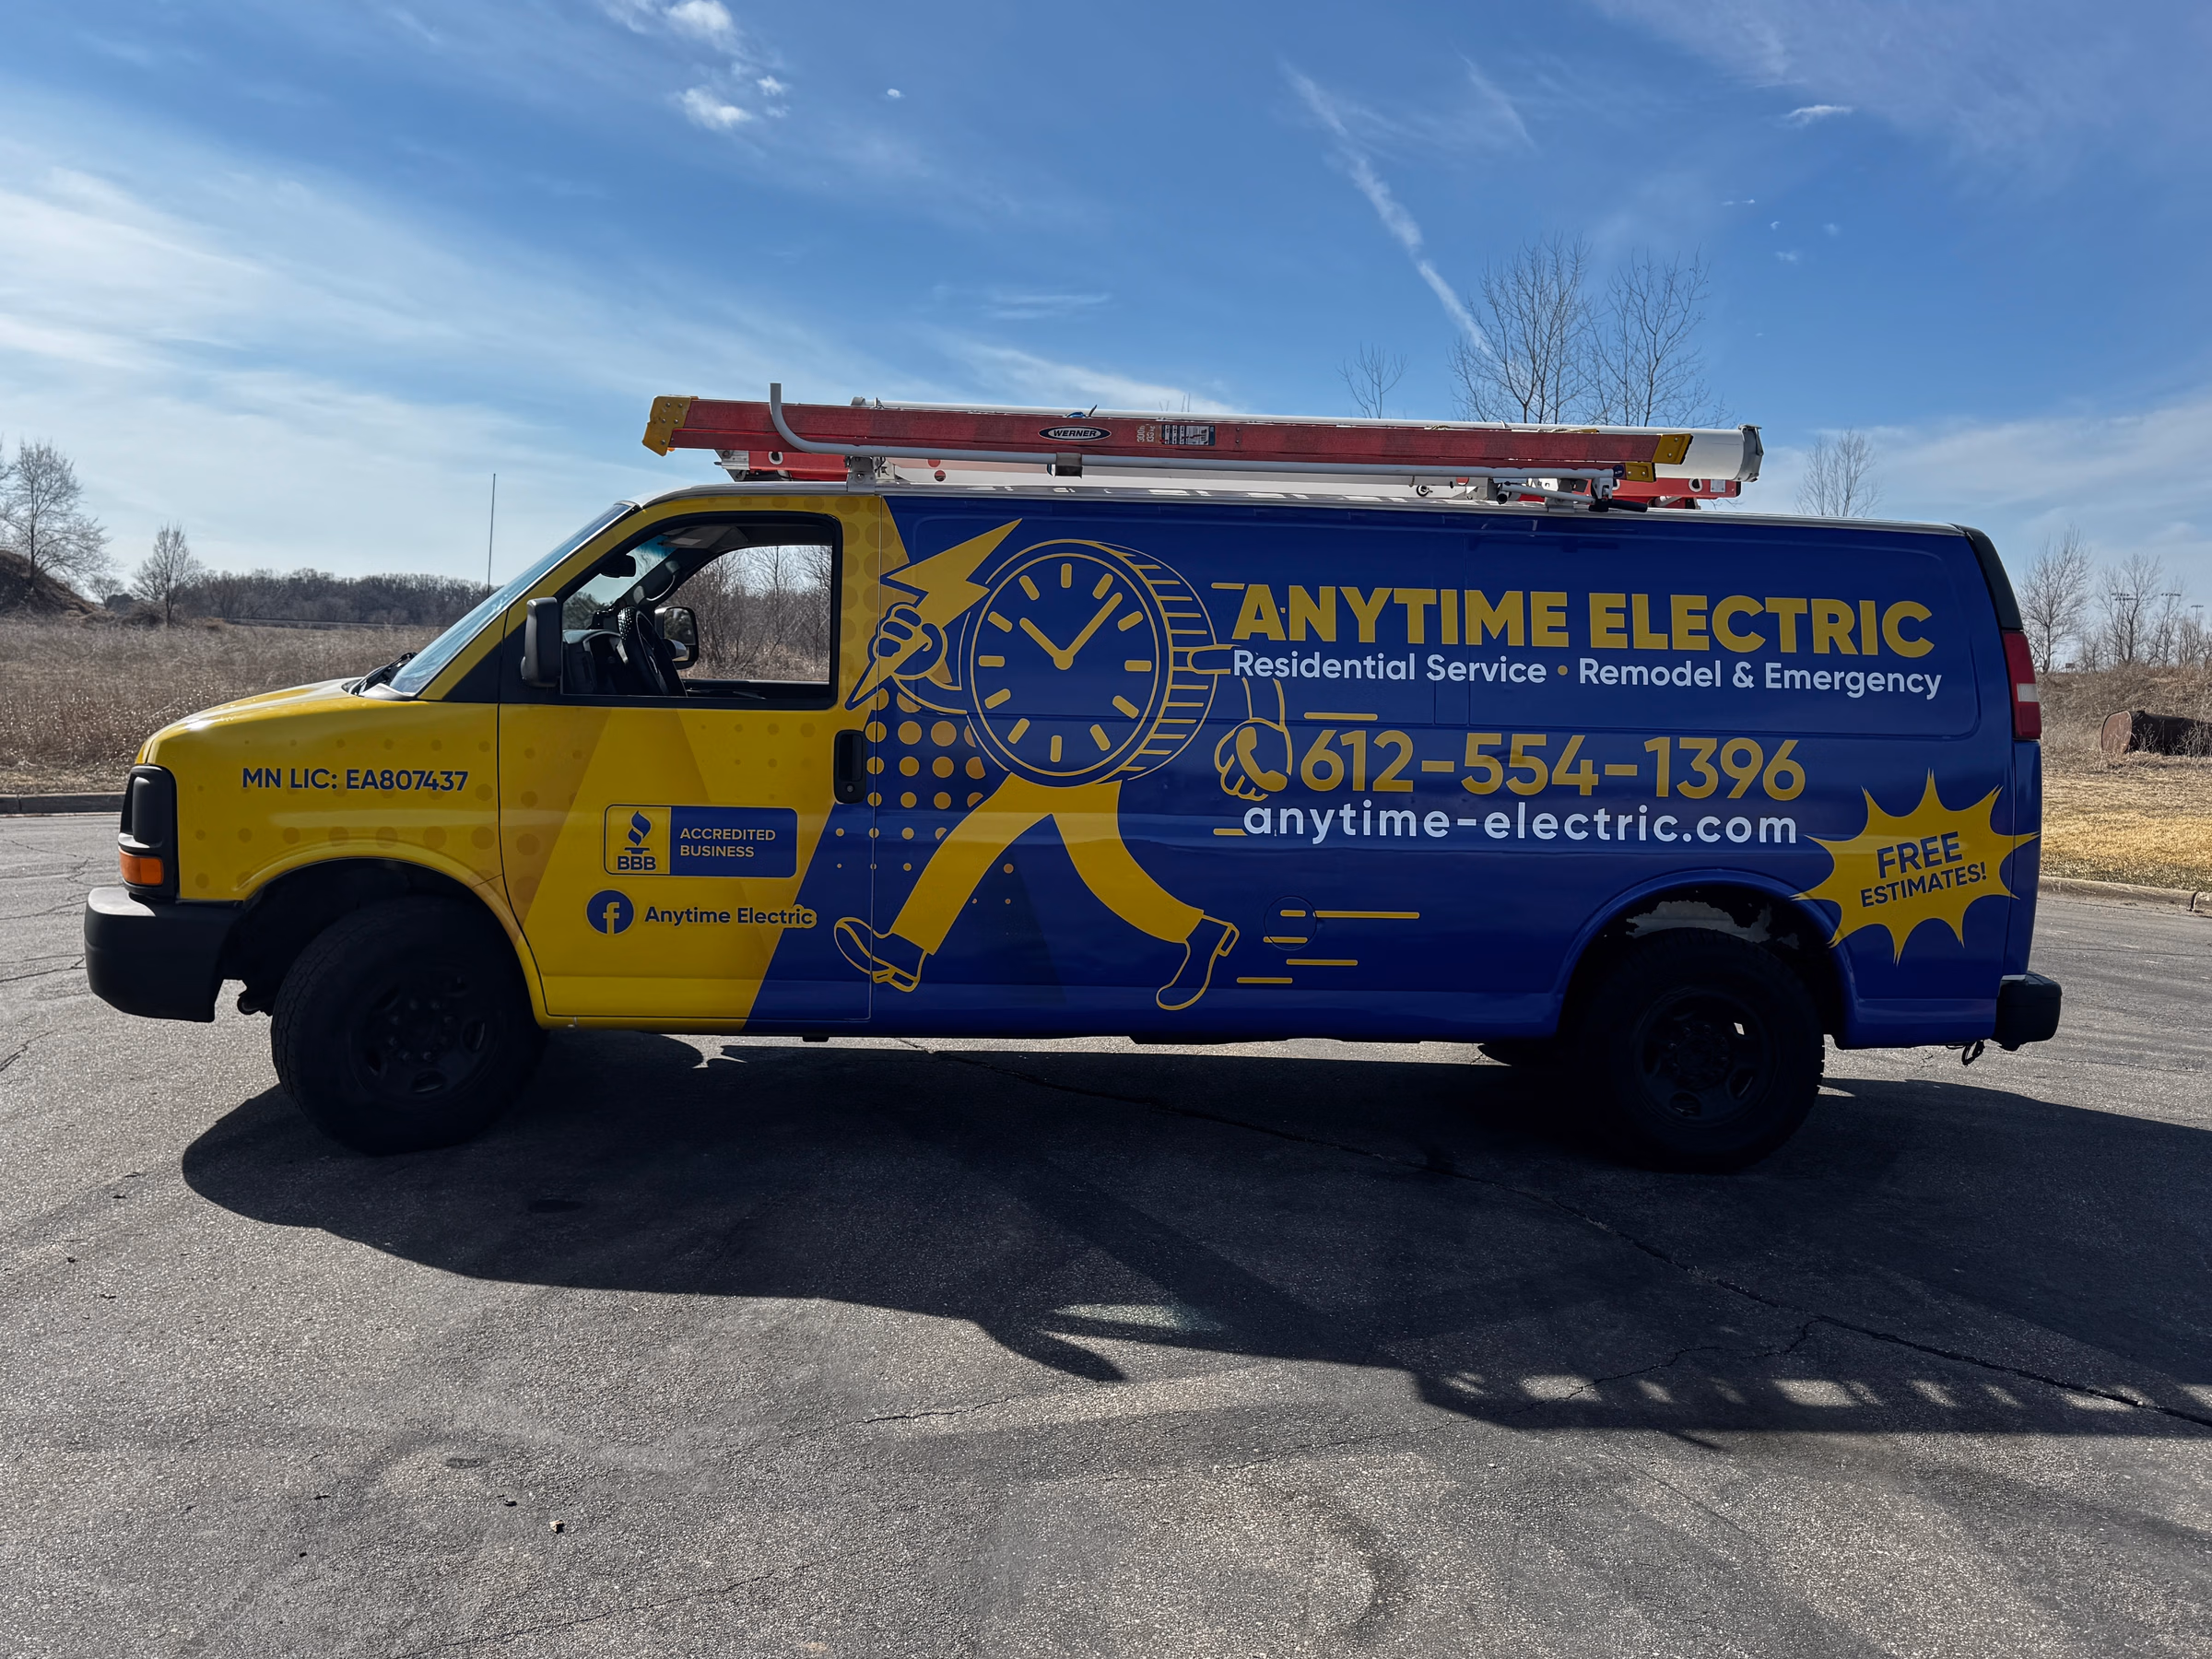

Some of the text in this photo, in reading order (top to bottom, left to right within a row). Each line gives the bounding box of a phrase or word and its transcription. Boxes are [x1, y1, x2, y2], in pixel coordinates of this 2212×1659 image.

[1053, 429, 1097, 438] WERNER
[1231, 583, 1935, 659] ANYTIME ELECTRIC
[1233, 649, 1943, 700] Residential Service Remodel & Emergency
[241, 768, 469, 792] MN LIC: EA807437
[1300, 729, 1806, 802] 612-554-1396
[679, 828, 777, 841] ACCREDITED
[1242, 800, 1796, 846] anytime-electric.com
[617, 855, 657, 871] BBB
[679, 845, 756, 859] BUSINESS
[1876, 830, 1963, 879] FREE
[1859, 861, 1988, 908] ESTIMATES!
[644, 906, 814, 927] Anytime Electric
